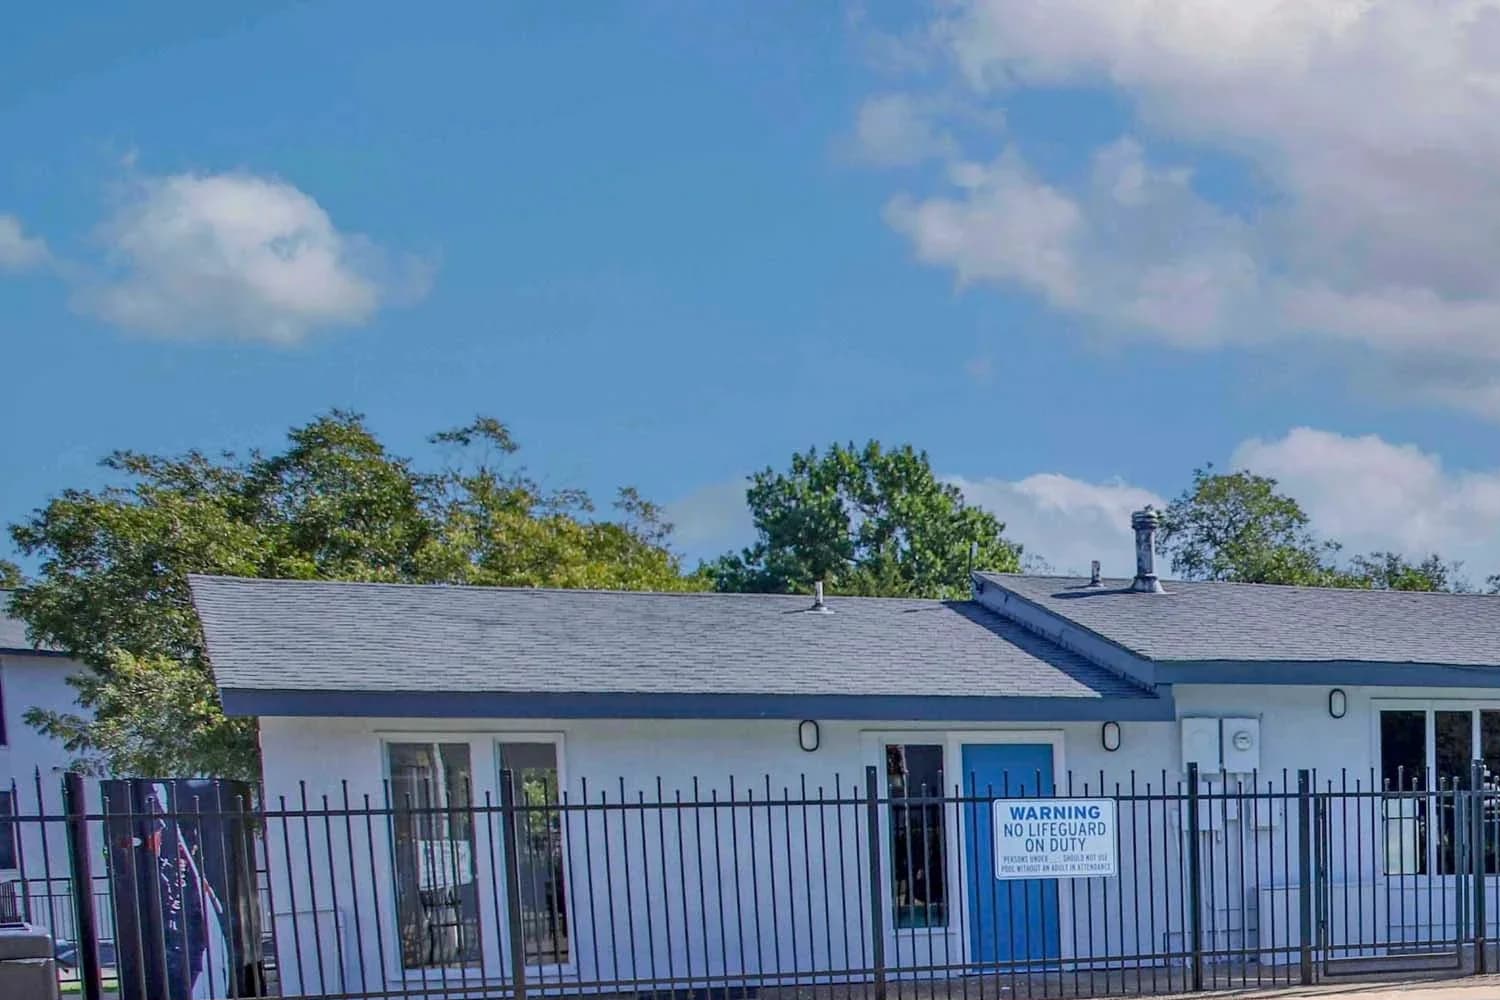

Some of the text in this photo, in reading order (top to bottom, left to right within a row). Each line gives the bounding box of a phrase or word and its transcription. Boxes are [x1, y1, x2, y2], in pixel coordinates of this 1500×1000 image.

[1009, 806, 1101, 821] WARNING
[1004, 822, 1106, 837] NO LIFEGUARD
[1025, 837, 1086, 852] ON DUTY
